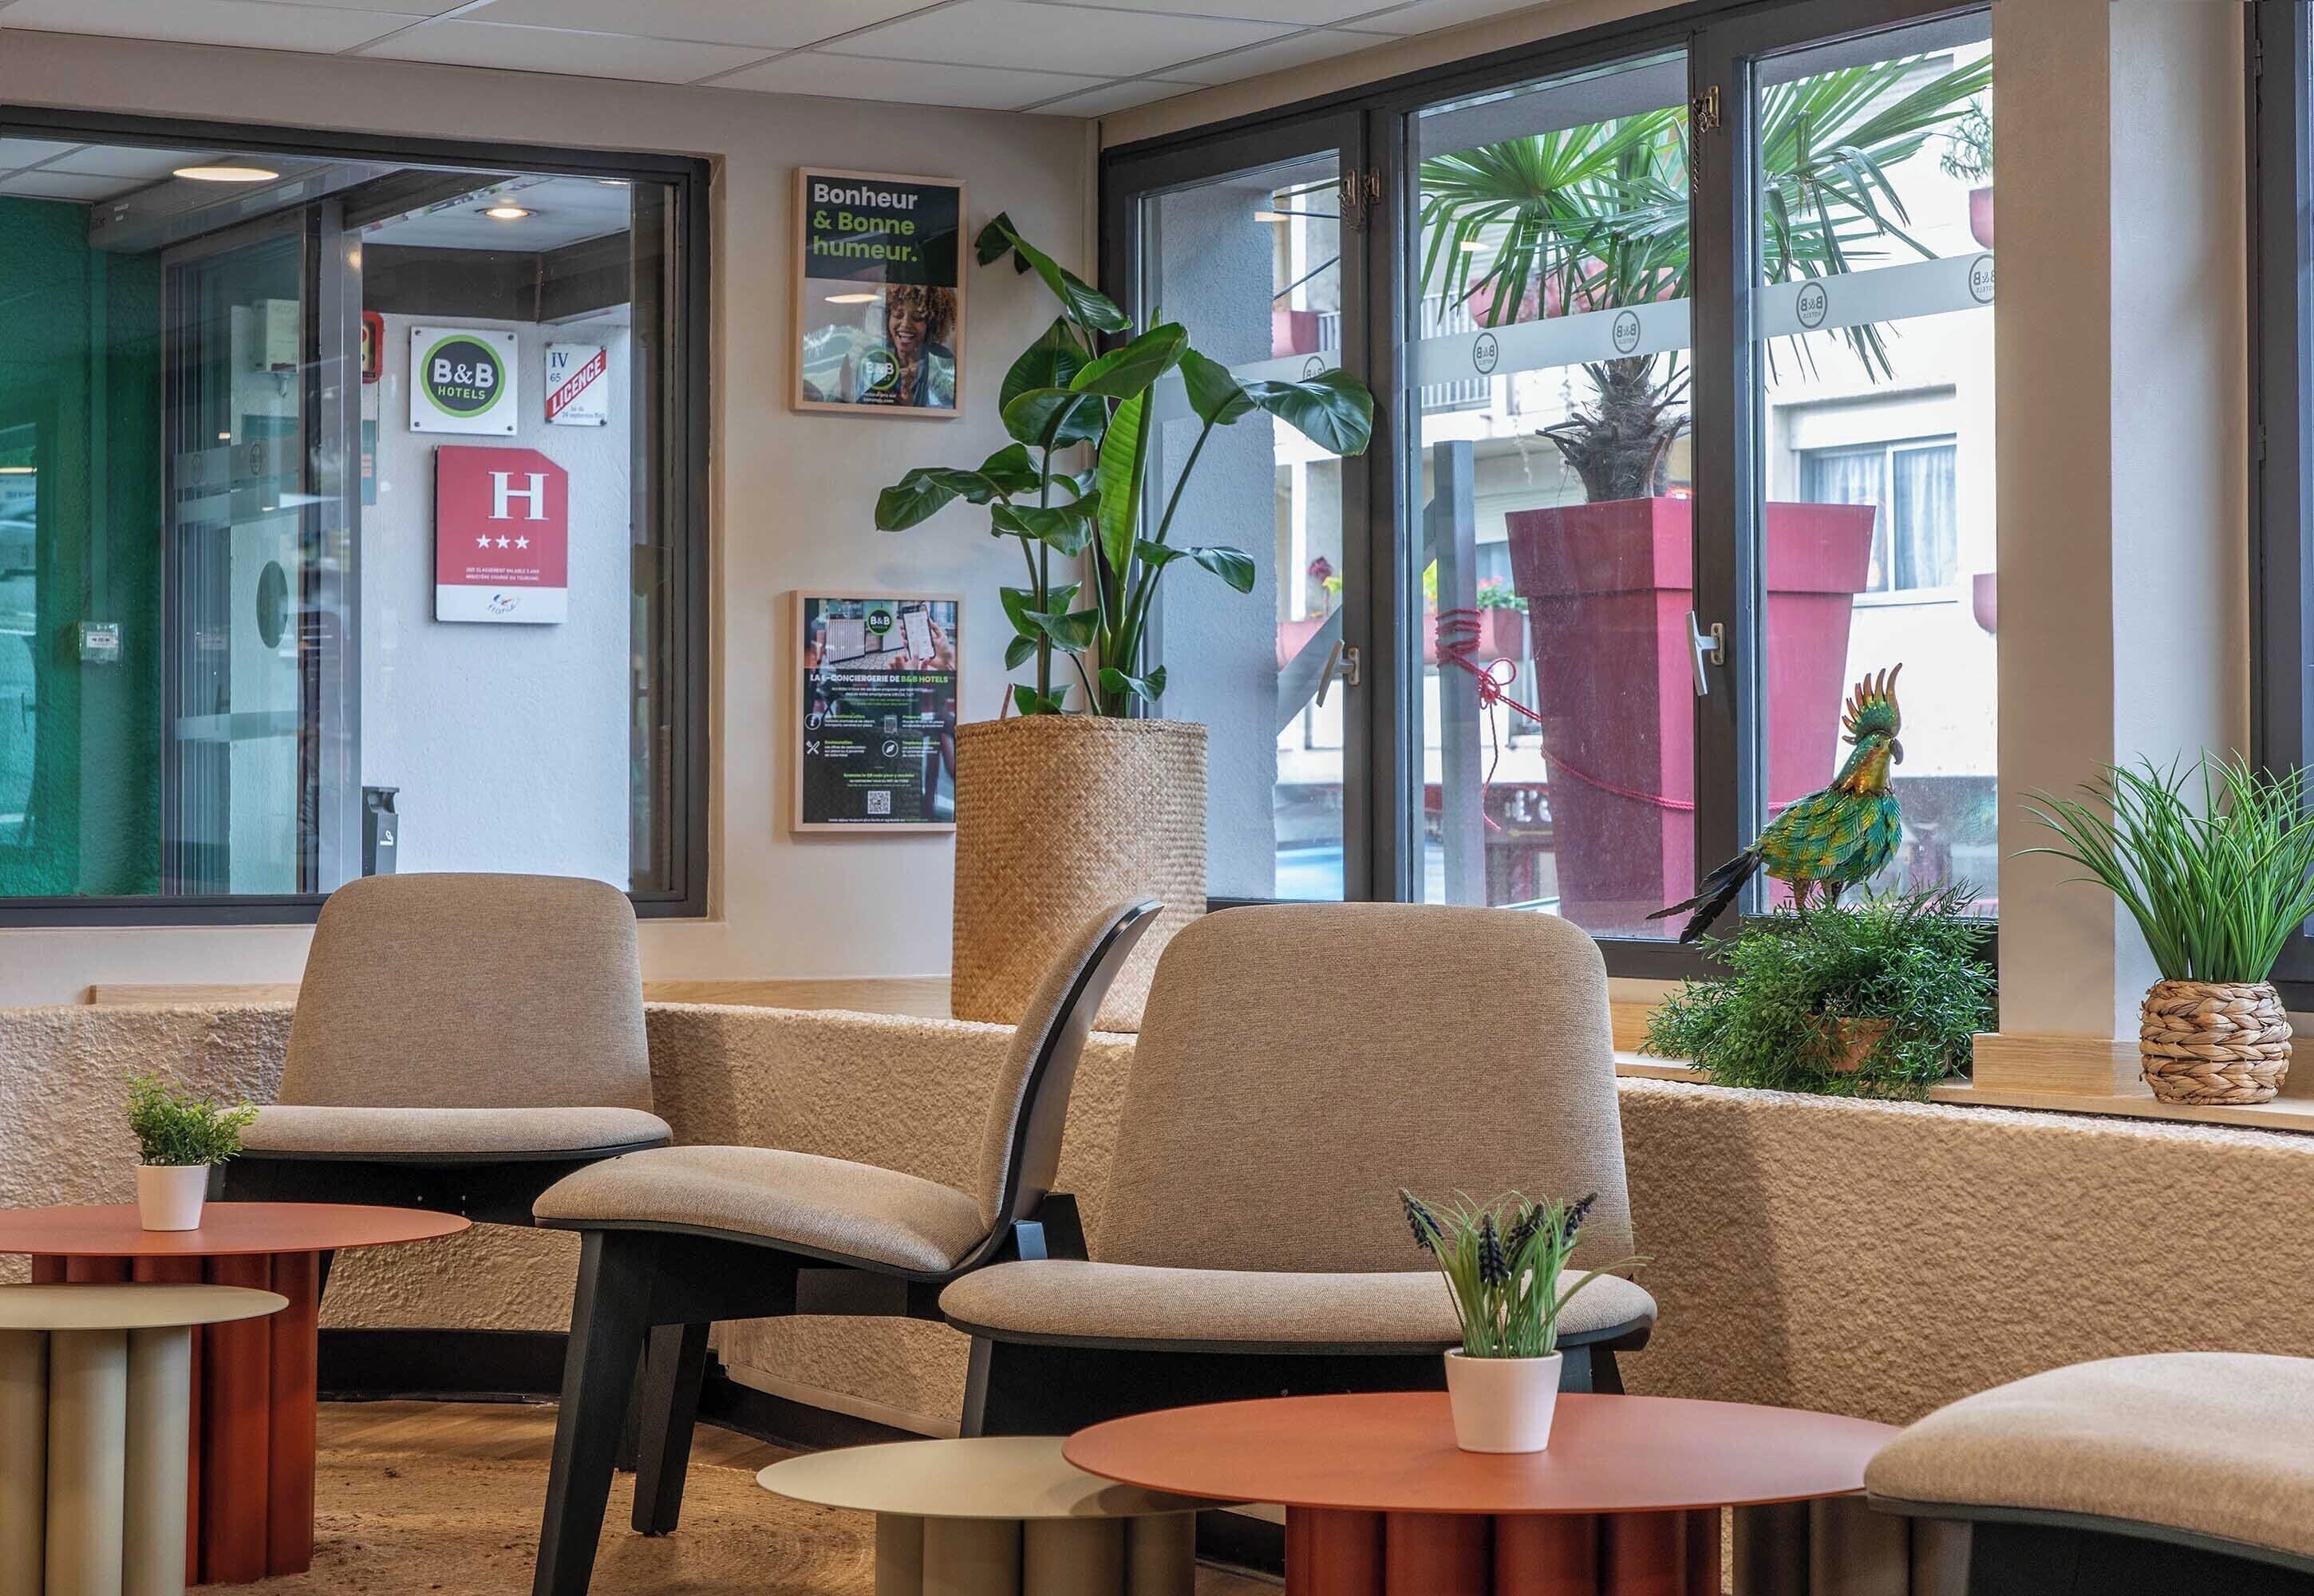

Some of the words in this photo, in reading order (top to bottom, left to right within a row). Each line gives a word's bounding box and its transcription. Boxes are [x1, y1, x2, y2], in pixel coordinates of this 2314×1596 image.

[814, 184, 918, 209] Bonheur
[813, 210, 832, 230] &
[838, 211, 915, 235] Bonne
[813, 235, 918, 263] humeur.
[551, 352, 569, 368] IV
[866, 361, 894, 375] B&B
[433, 358, 494, 388] B&B
[550, 373, 562, 382] 65
[437, 385, 486, 400] HOTELS
[552, 355, 601, 415] LICENCE
[488, 472, 550, 520] H
[870, 615, 890, 626] B&B
[889, 674, 900, 683] DE
